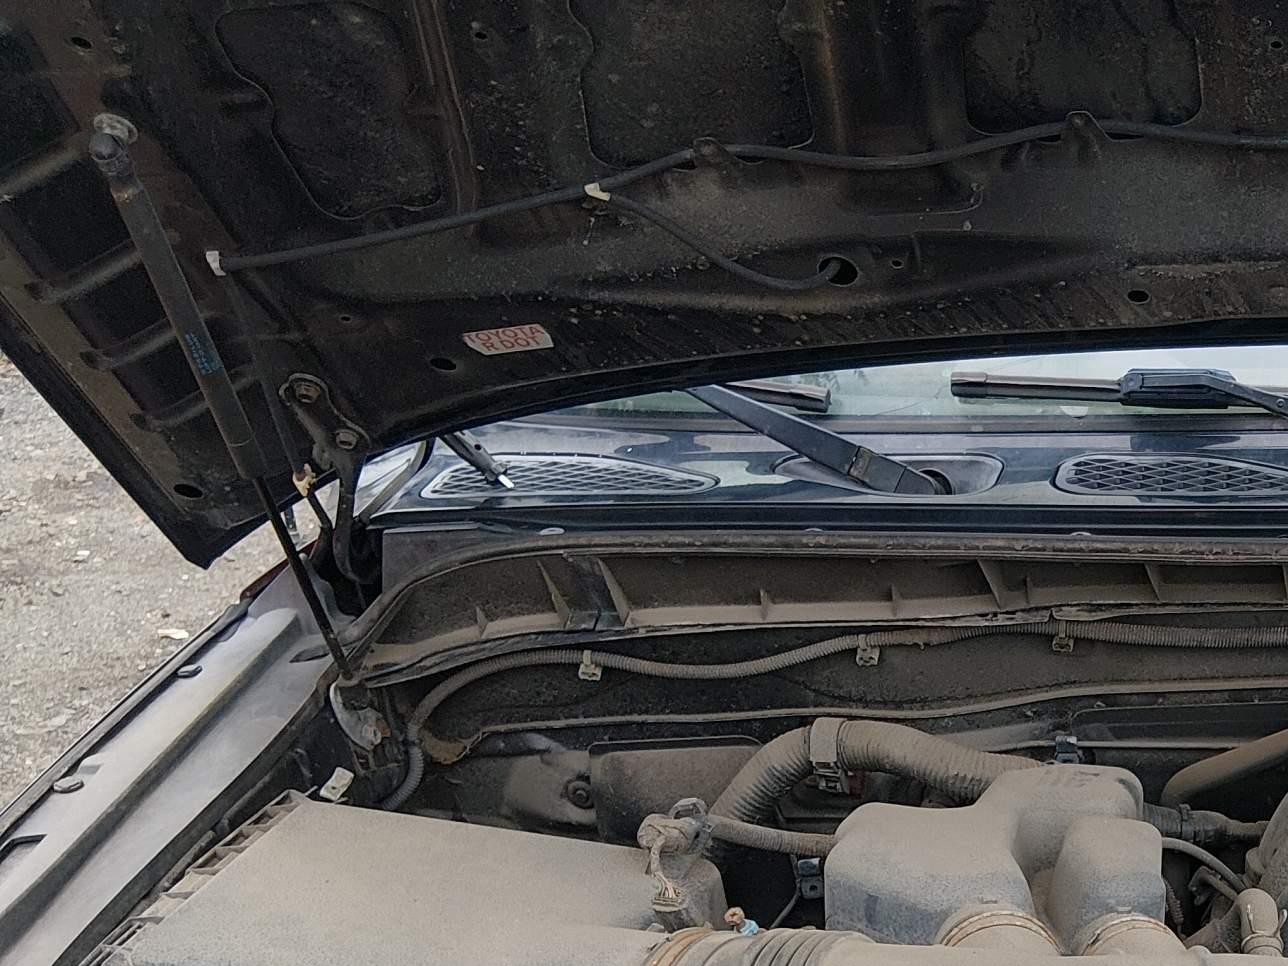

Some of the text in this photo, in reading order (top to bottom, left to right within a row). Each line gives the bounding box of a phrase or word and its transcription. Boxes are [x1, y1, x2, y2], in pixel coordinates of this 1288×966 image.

[464, 326, 545, 344] TOYOTA
[481, 336, 540, 352] R DOT
